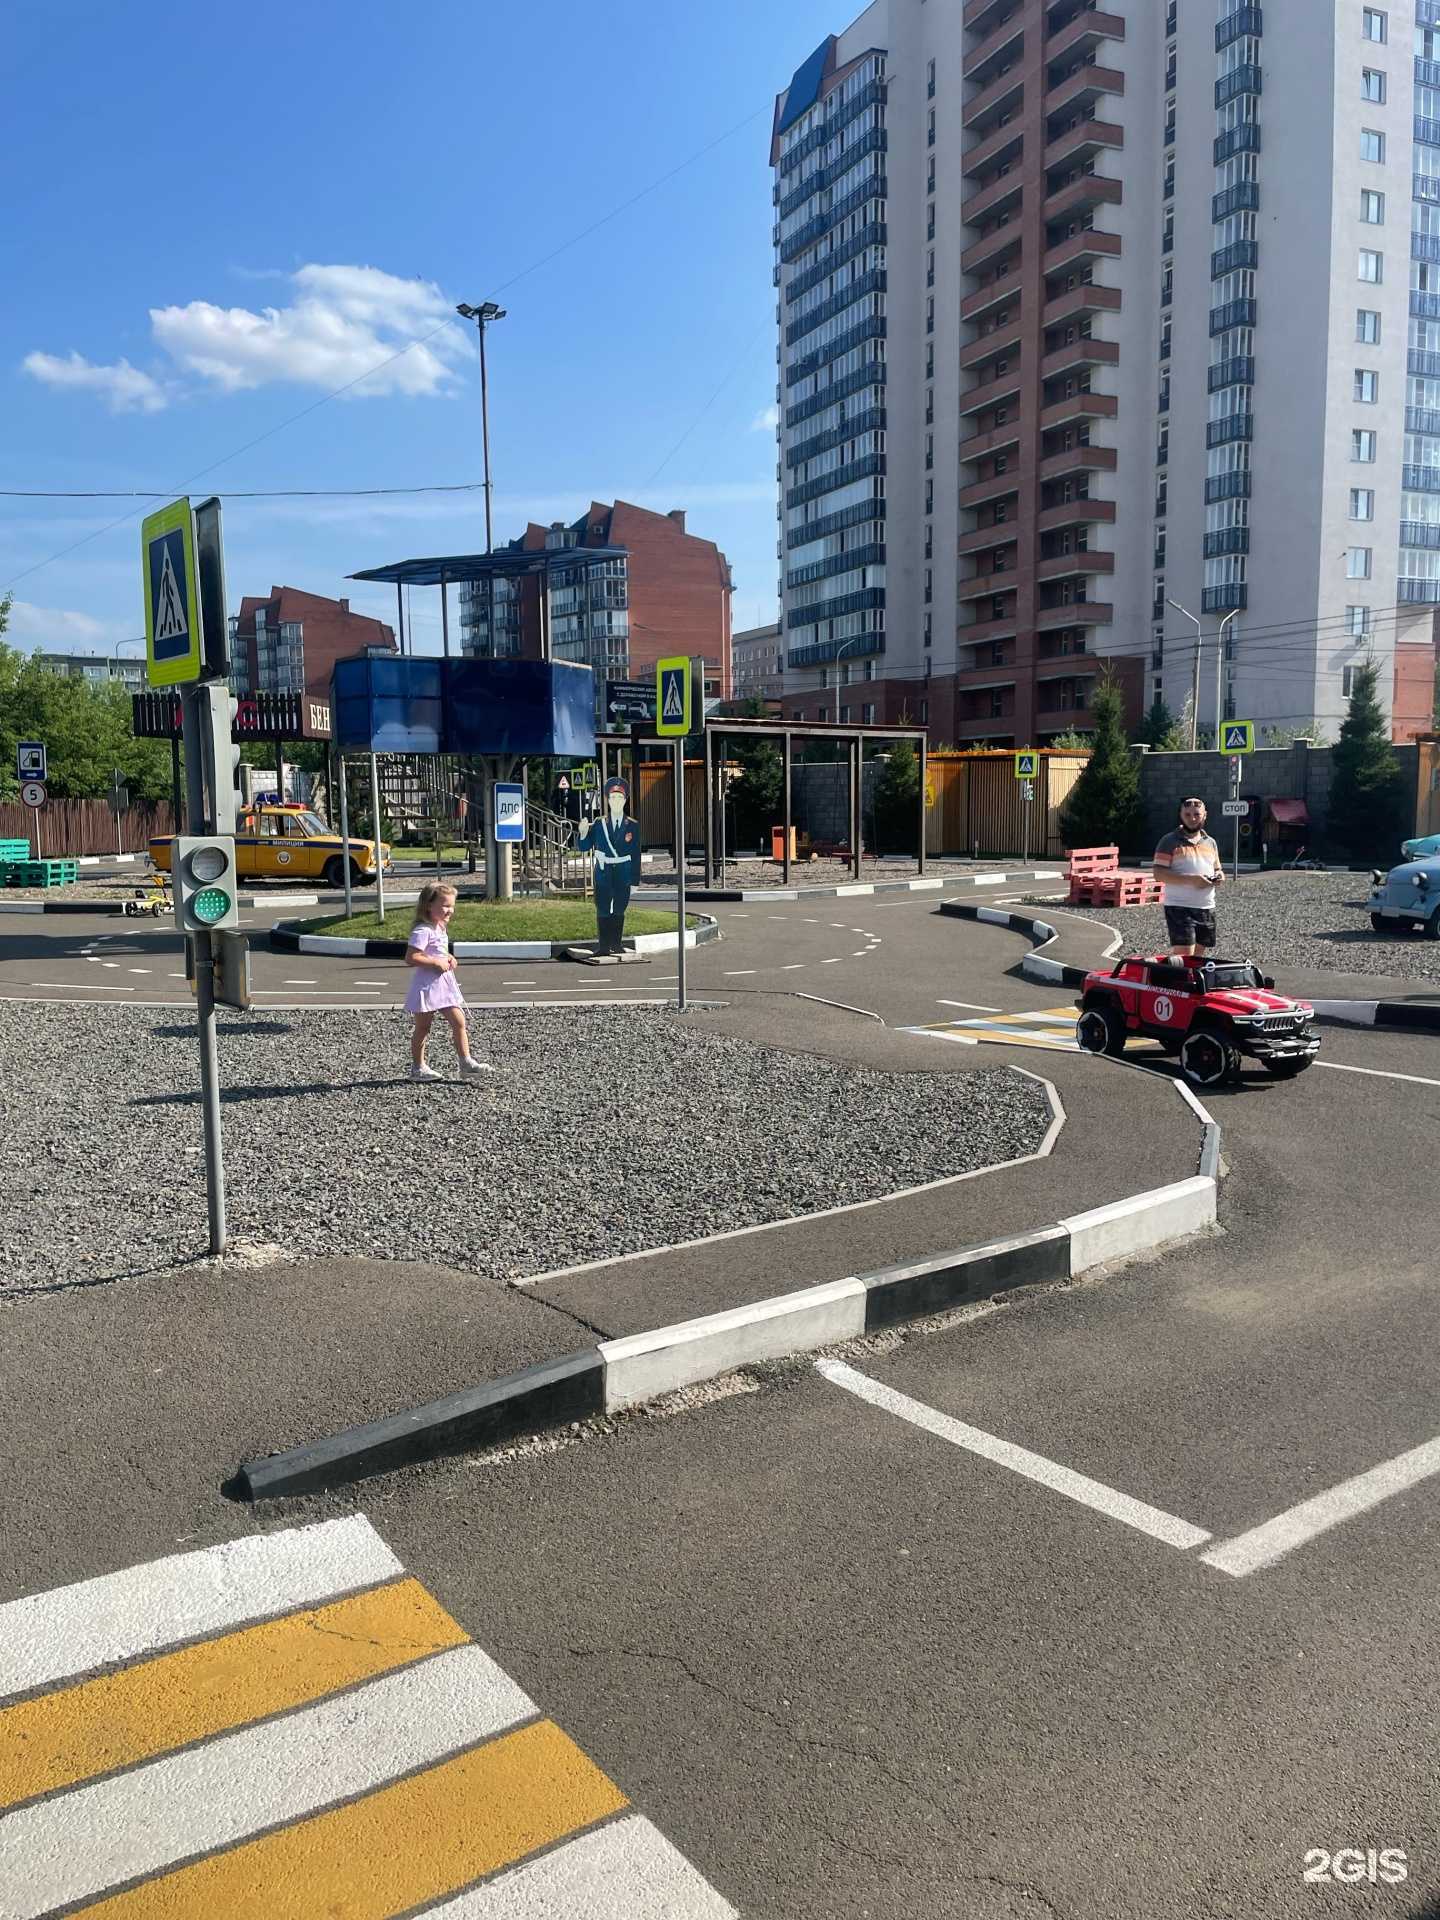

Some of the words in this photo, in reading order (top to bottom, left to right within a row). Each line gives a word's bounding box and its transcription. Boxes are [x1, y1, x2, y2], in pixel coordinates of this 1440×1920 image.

[30, 789, 38, 801] 5
[500, 802, 520, 815] ДПС
[1224, 804, 1246, 813] СТОП
[1156, 1000, 1171, 1017] 01
